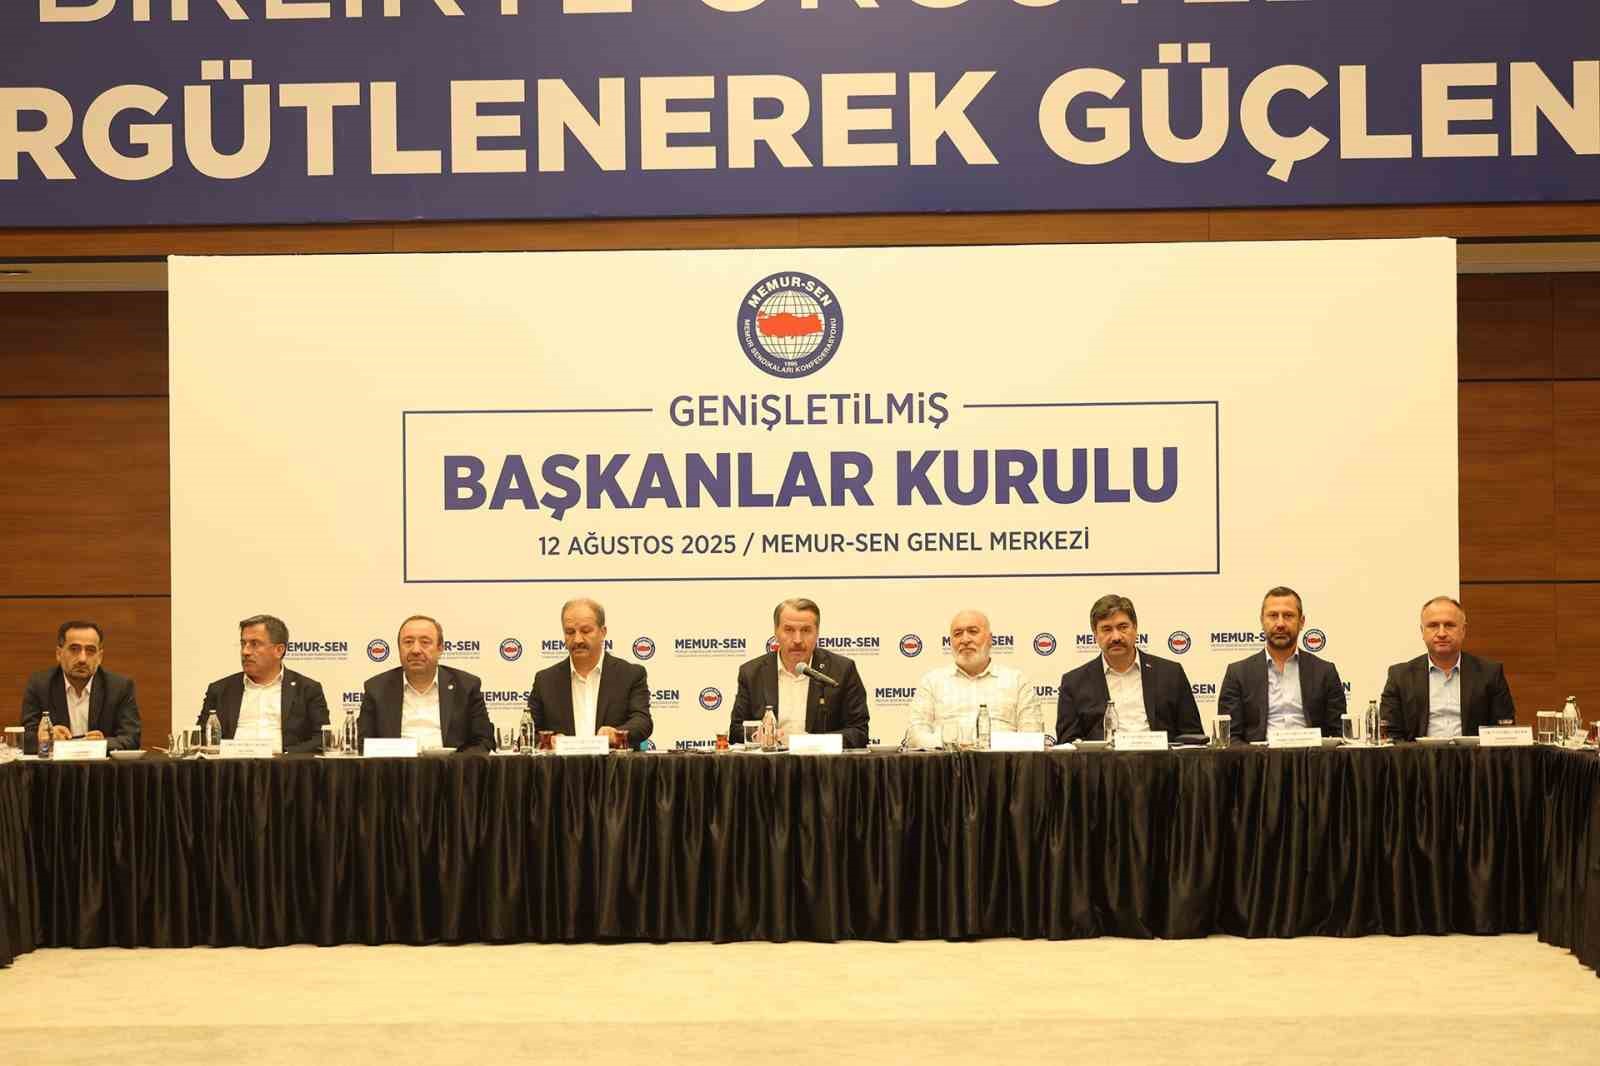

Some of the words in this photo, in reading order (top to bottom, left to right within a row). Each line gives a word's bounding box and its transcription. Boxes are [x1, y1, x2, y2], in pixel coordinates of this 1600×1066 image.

[0, 59, 999, 181] RGÜTLENEREK
[1038, 43, 1600, 183] GÜÇLEN
[748, 276, 832, 309] MEMUR-SEN
[443, 451, 875, 521] BAŞKANLAR
[896, 446, 1178, 505] KURULU
[538, 536, 560, 556] 12
[567, 531, 674, 556] AĞUSTOS
[681, 534, 736, 554] 2025
[742, 532, 755, 557] /
[762, 532, 899, 553] MEMUR-SEN
[907, 531, 983, 552] GENEL
[990, 526, 1089, 551] MERKEZİ
[287, 641, 348, 652] EMUR-SEN
[675, 638, 746, 649] MEMUR-SEN
[817, 637, 880, 648] EMUR-SEN
[1211, 632, 1266, 643] MEMUR-S
